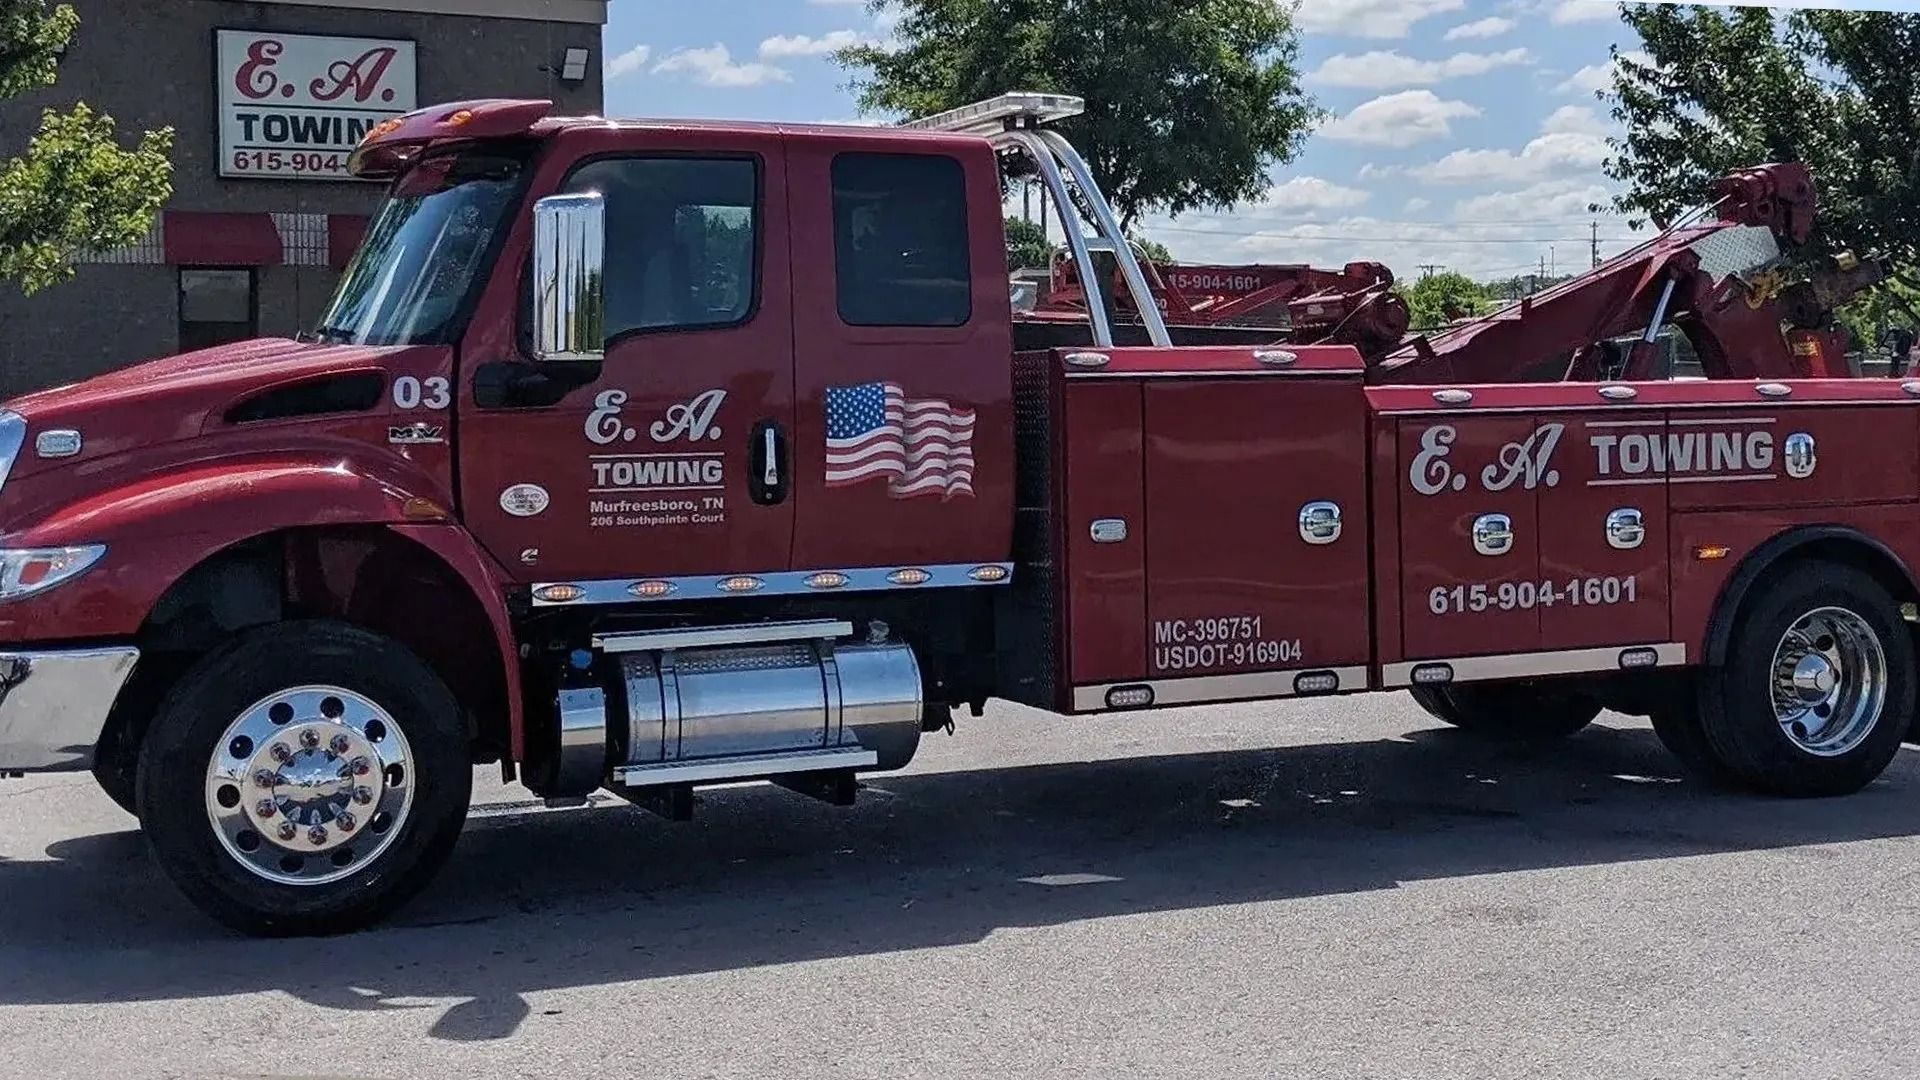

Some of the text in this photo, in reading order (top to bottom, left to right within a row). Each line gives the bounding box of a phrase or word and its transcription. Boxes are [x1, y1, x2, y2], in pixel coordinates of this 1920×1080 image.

[235, 39, 398, 103] E. A.
[236, 113, 374, 145] TOWIN
[233, 151, 347, 173] 615-904-
[1168, 273, 1261, 291] 15-904-1601
[393, 375, 451, 410] 03
[584, 389, 728, 444] E. A.
[592, 460, 723, 486] TOWING
[1409, 423, 1775, 496] E. A. TOWING
[590, 497, 724, 513] Murfreesboro, TN
[590, 513, 725, 527] 206 Southpointe Court
[1428, 576, 1637, 615] 615-904-1601
[1155, 615, 1263, 644] MC-396751
[1155, 639, 1303, 670] USDOT-916904
